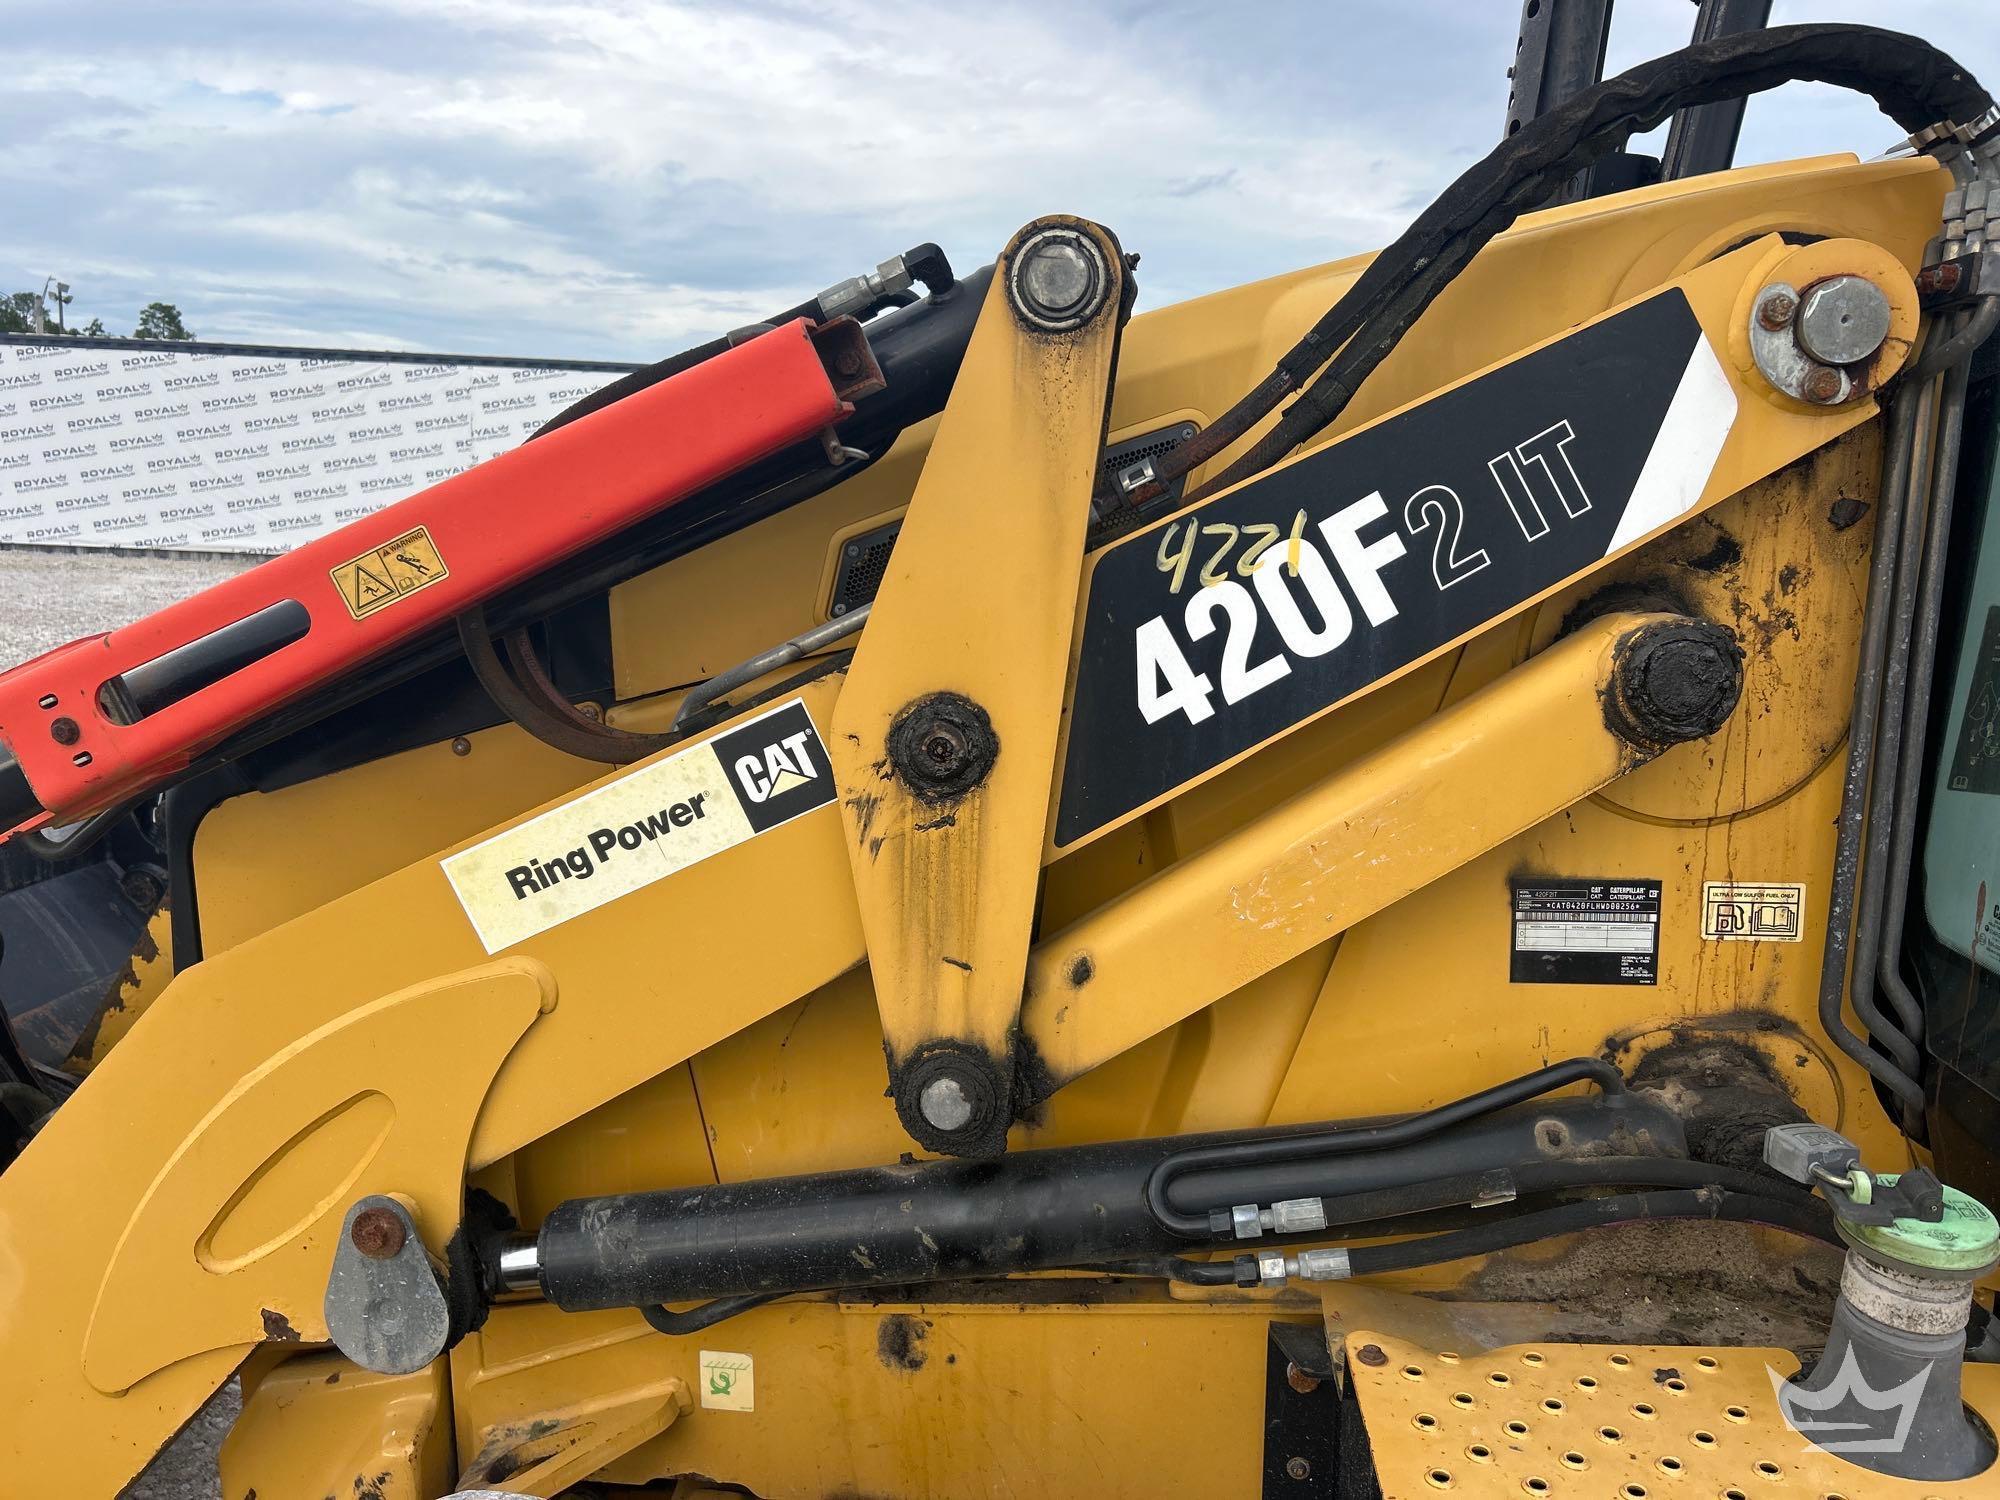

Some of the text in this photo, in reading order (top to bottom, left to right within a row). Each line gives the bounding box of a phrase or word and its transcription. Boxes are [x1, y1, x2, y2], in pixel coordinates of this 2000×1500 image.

[122, 355, 164, 367] ROYAL
[55, 364, 97, 377] ROYAL
[232, 365, 275, 377] ROYAL
[405, 365, 447, 378] ROYAL
[0, 376, 30, 386] OYAL
[165, 375, 207, 387] ROYAL
[338, 375, 380, 388] ROYAL
[97, 385, 139, 397] ROYAL
[270, 386, 313, 398] ROYAL
[550, 387, 589, 400] ROYAL
[30, 395, 72, 407] ROYAL
[203, 396, 245, 408] ROYAL
[379, 395, 421, 408] ROYAL
[482, 397, 524, 409] ROYAL
[135, 405, 177, 418] ROYAL
[312, 406, 354, 418] ROYAL
[68, 415, 110, 428] ROYAL
[245, 416, 287, 428] ROYAL
[415, 416, 457, 428] ROYAL
[1, 426, 43, 438] ROYAL
[177, 426, 219, 438] ROYAL
[349, 426, 391, 438] ROYAL
[110, 435, 152, 448] ROYAL
[282, 436, 324, 449] ROYAL
[43, 445, 85, 458] ROYAL
[215, 446, 257, 459] ROYAL
[389, 445, 432, 458] ROYAL
[148, 456, 190, 468] ROYAL
[323, 456, 366, 468] ROYAL
[80, 466, 123, 478] ROYAL
[257, 466, 299, 478] ROYAL
[14, 476, 56, 488] ROYAL
[190, 476, 232, 488] ROYAL
[360, 476, 402, 488] ROYAL
[123, 486, 165, 498] ROYAL
[294, 486, 336, 499] ROYAL
[56, 496, 98, 508] ROYAL
[227, 496, 269, 509] ROYAL
[0, 506, 32, 517] OYAL
[160, 506, 202, 518] ROYAL
[93, 516, 135, 528] ROYAL
[269, 516, 311, 528] ROYAL
[27, 526, 69, 538] ROYAL
[202, 525, 244, 538] ROYAL
[134, 534, 178, 546] ROYAL
[389, 531, 424, 552] WARNING
[734, 731, 818, 803] CAT
[505, 846, 595, 901] Ring
